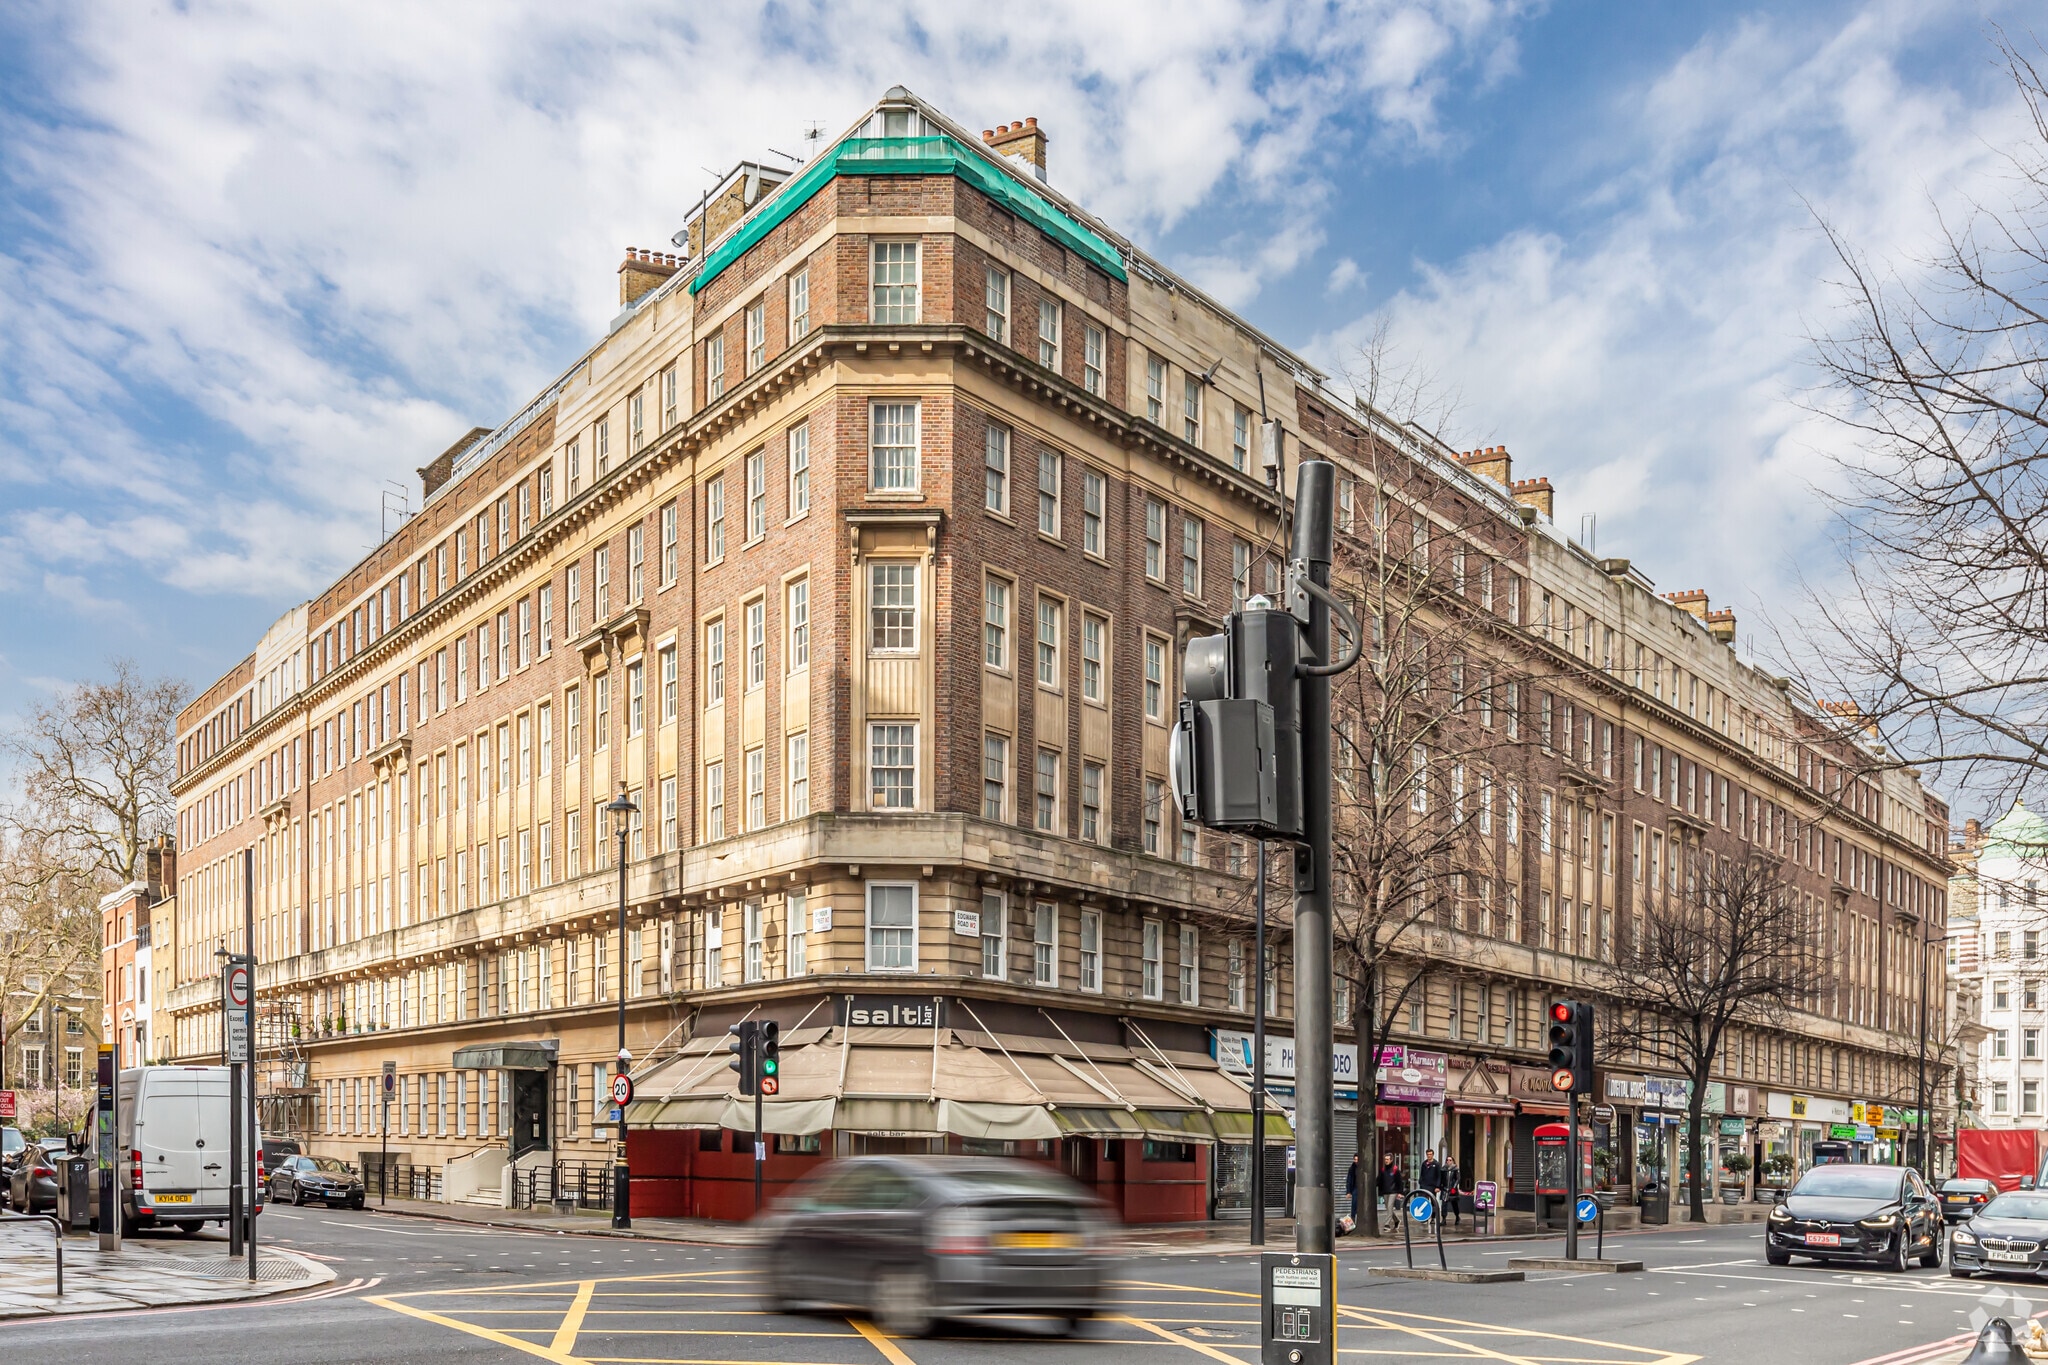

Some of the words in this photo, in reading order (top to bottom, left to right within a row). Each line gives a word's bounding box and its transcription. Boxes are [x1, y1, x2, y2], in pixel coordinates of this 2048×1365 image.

[957, 912, 977, 920] EDGWARE
[957, 920, 969, 928] ROAD
[851, 1004, 917, 1025] salt
[921, 1005, 933, 1025] bar
[1373, 1046, 1403, 1054] PRMACY
[1281, 1048, 1294, 1069] PH
[1333, 1053, 1352, 1074] DEO
[1409, 1052, 1436, 1070] Pharmacy
[615, 1083, 627, 1096] 20
[1721, 1121, 1743, 1129] PLAZA
[74, 1163, 84, 1171] 27
[158, 1195, 174, 1203] KY14
[1992, 1252, 2008, 1260] FP16
[1275, 1267, 1318, 1276] PEDESTRIANS
